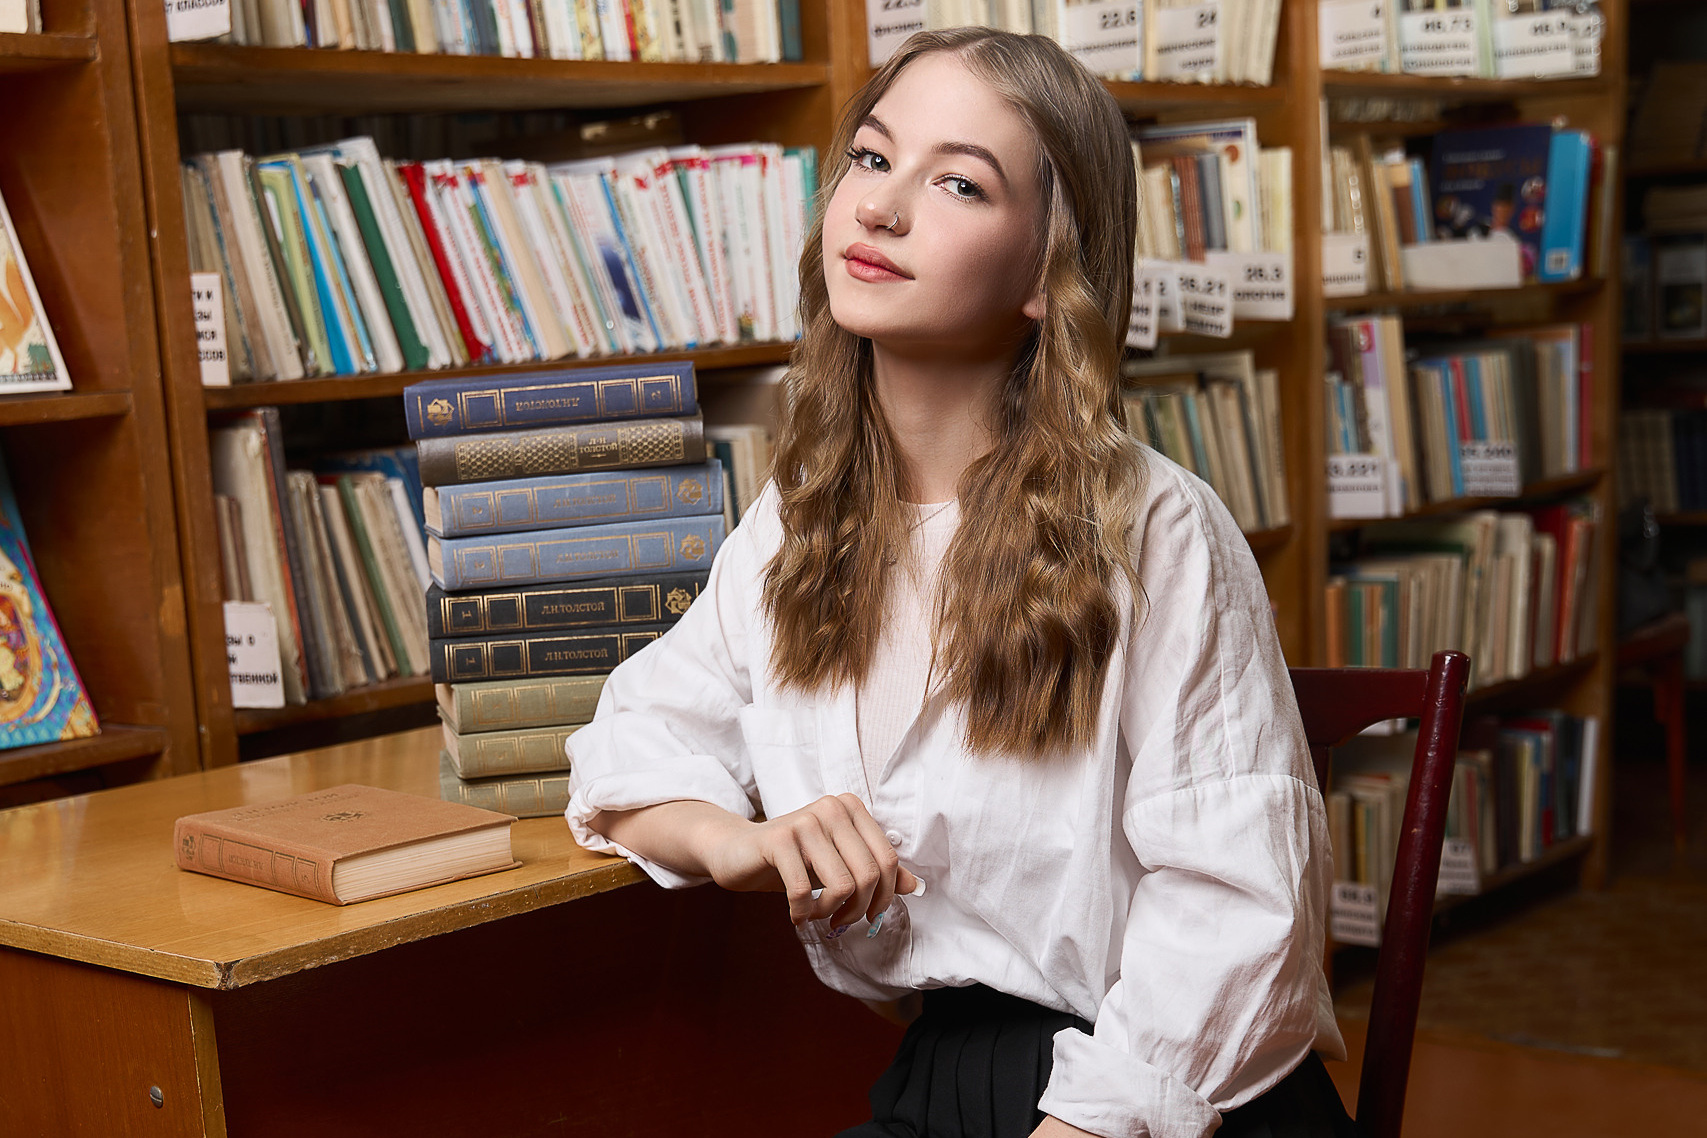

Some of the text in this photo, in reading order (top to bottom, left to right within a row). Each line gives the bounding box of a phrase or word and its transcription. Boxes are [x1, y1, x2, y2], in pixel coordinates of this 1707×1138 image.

[579, 442, 619, 455] ТОЛСТОЙ
[541, 601, 606, 615] Л.Н.ТОЛСТОЙ
[544, 648, 609, 662] Л.Н.ТОЛСТОЙ
